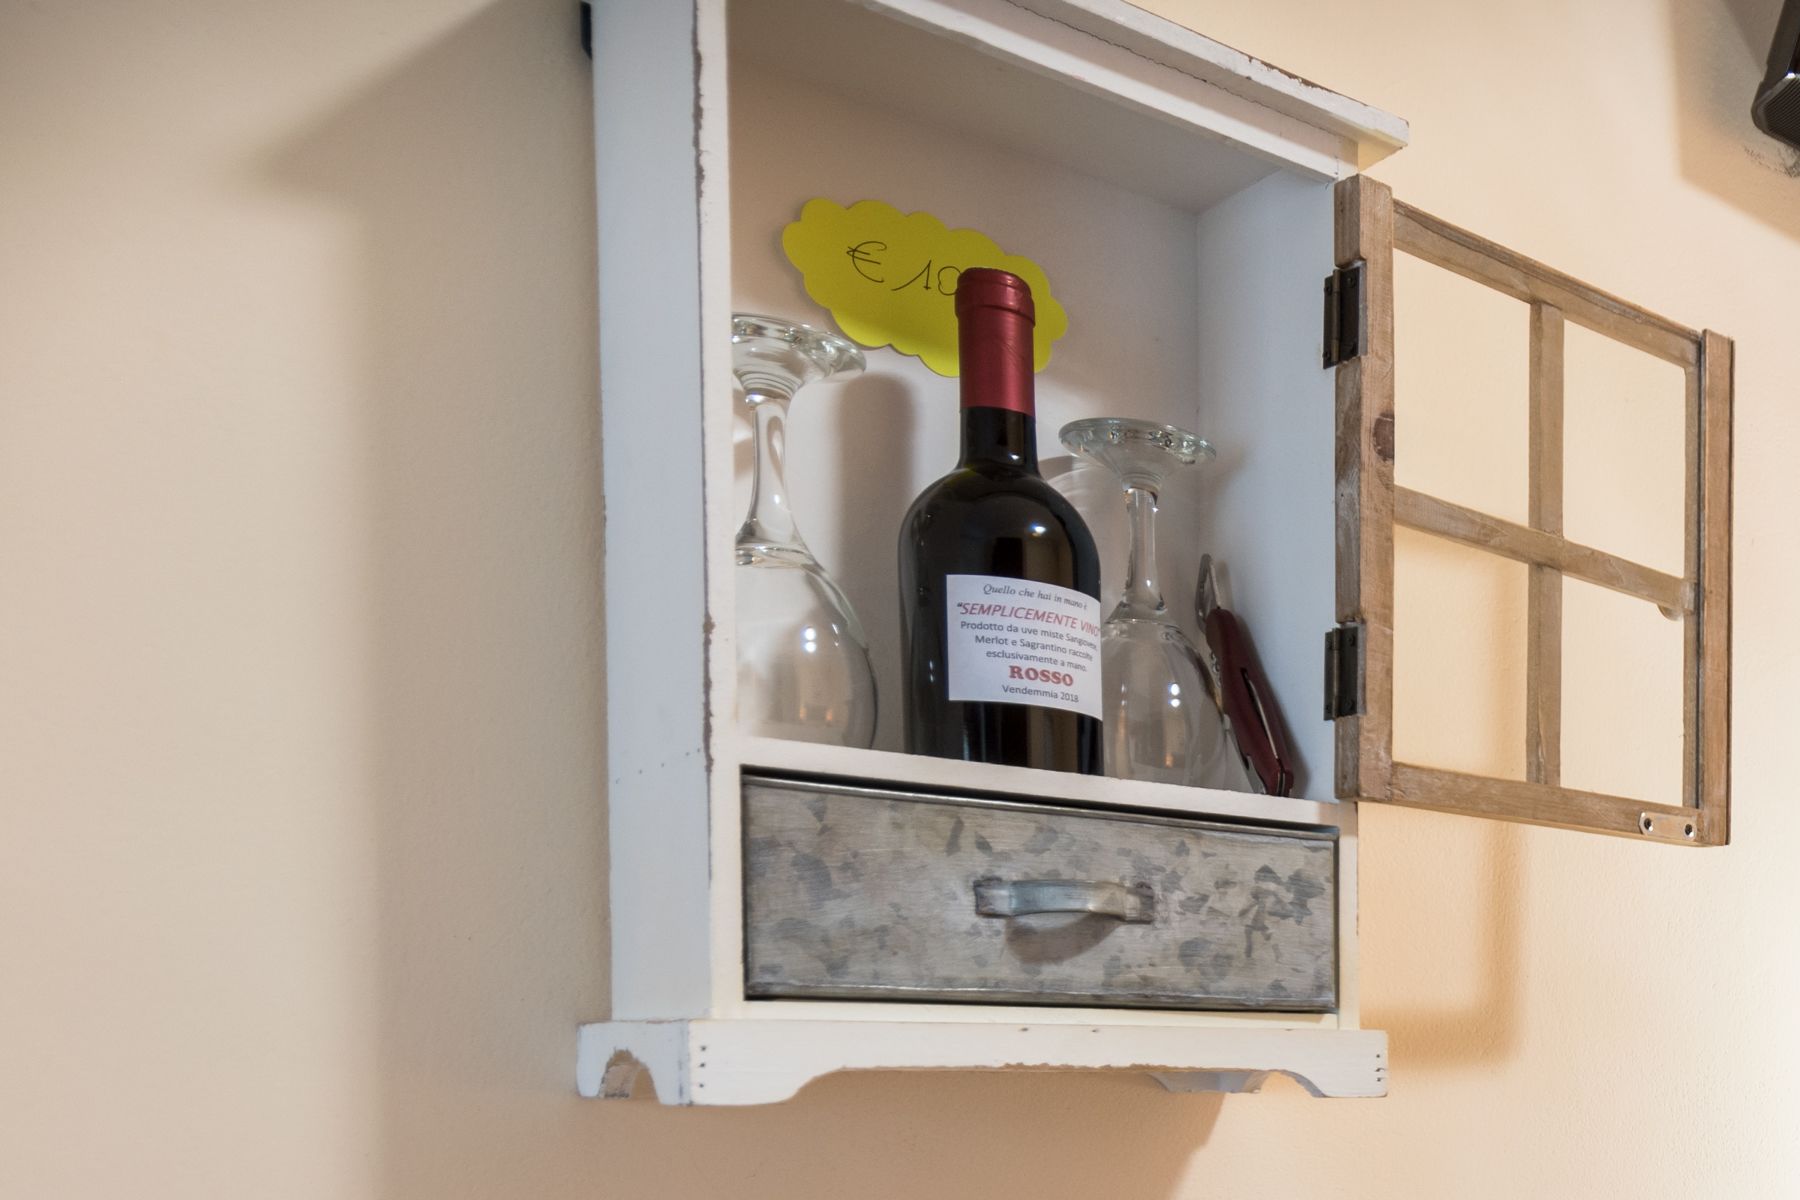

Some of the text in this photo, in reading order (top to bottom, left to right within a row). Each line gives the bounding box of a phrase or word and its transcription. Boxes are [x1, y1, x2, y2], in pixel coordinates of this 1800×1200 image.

[846, 240, 888, 283] €
[983, 583, 1016, 596] Quello
[1018, 588, 1035, 598] che
[1038, 590, 1052, 601] hai
[1054, 595, 1062, 603] in
[1063, 597, 1083, 609] mano
[960, 620, 1004, 632] Prodotto
[1006, 623, 1019, 634] da
[1021, 627, 1038, 635] uve
[1040, 629, 1064, 640] miste
[974, 634, 1008, 646] Merlot
[1011, 639, 1017, 647] e
[1020, 638, 1067, 655] Sagrantino
[985, 650, 1088, 673] esclusivamente a mano.
[1008, 665, 1074, 687] ROSSO
[1001, 684, 1079, 703] Vendemmia 2018
